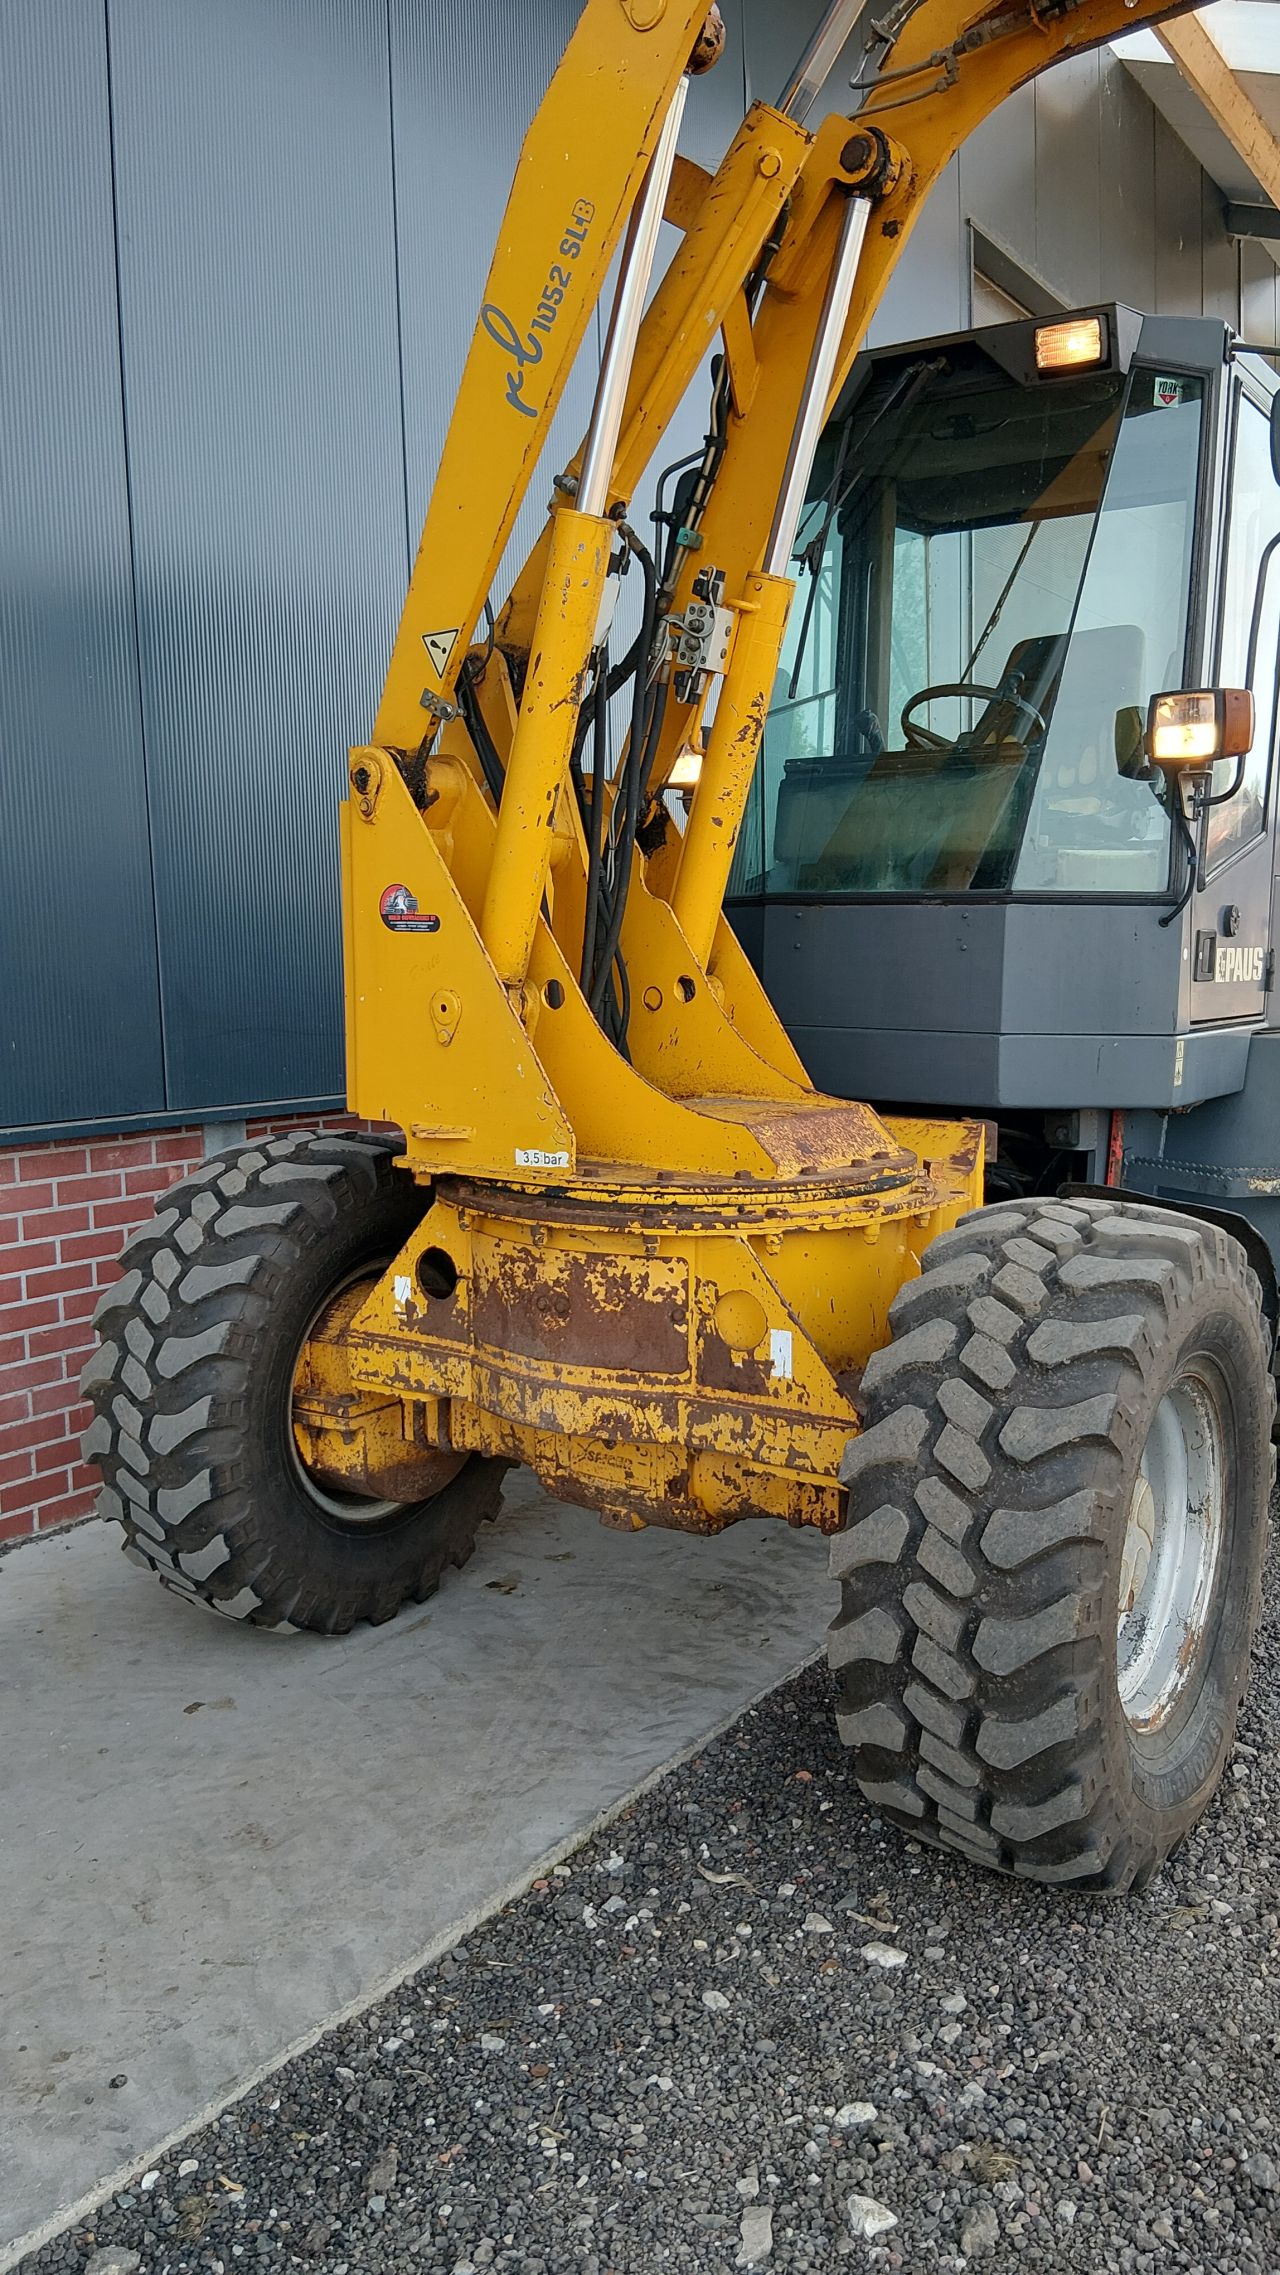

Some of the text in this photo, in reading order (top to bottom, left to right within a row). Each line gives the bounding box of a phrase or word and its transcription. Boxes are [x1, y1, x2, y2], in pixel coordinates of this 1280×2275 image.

[531, 264, 572, 334] 1052
[559, 198, 596, 260] SL-B
[1158, 380, 1179, 395] YORK
[523, 1151, 563, 1165] 3,5 bar
